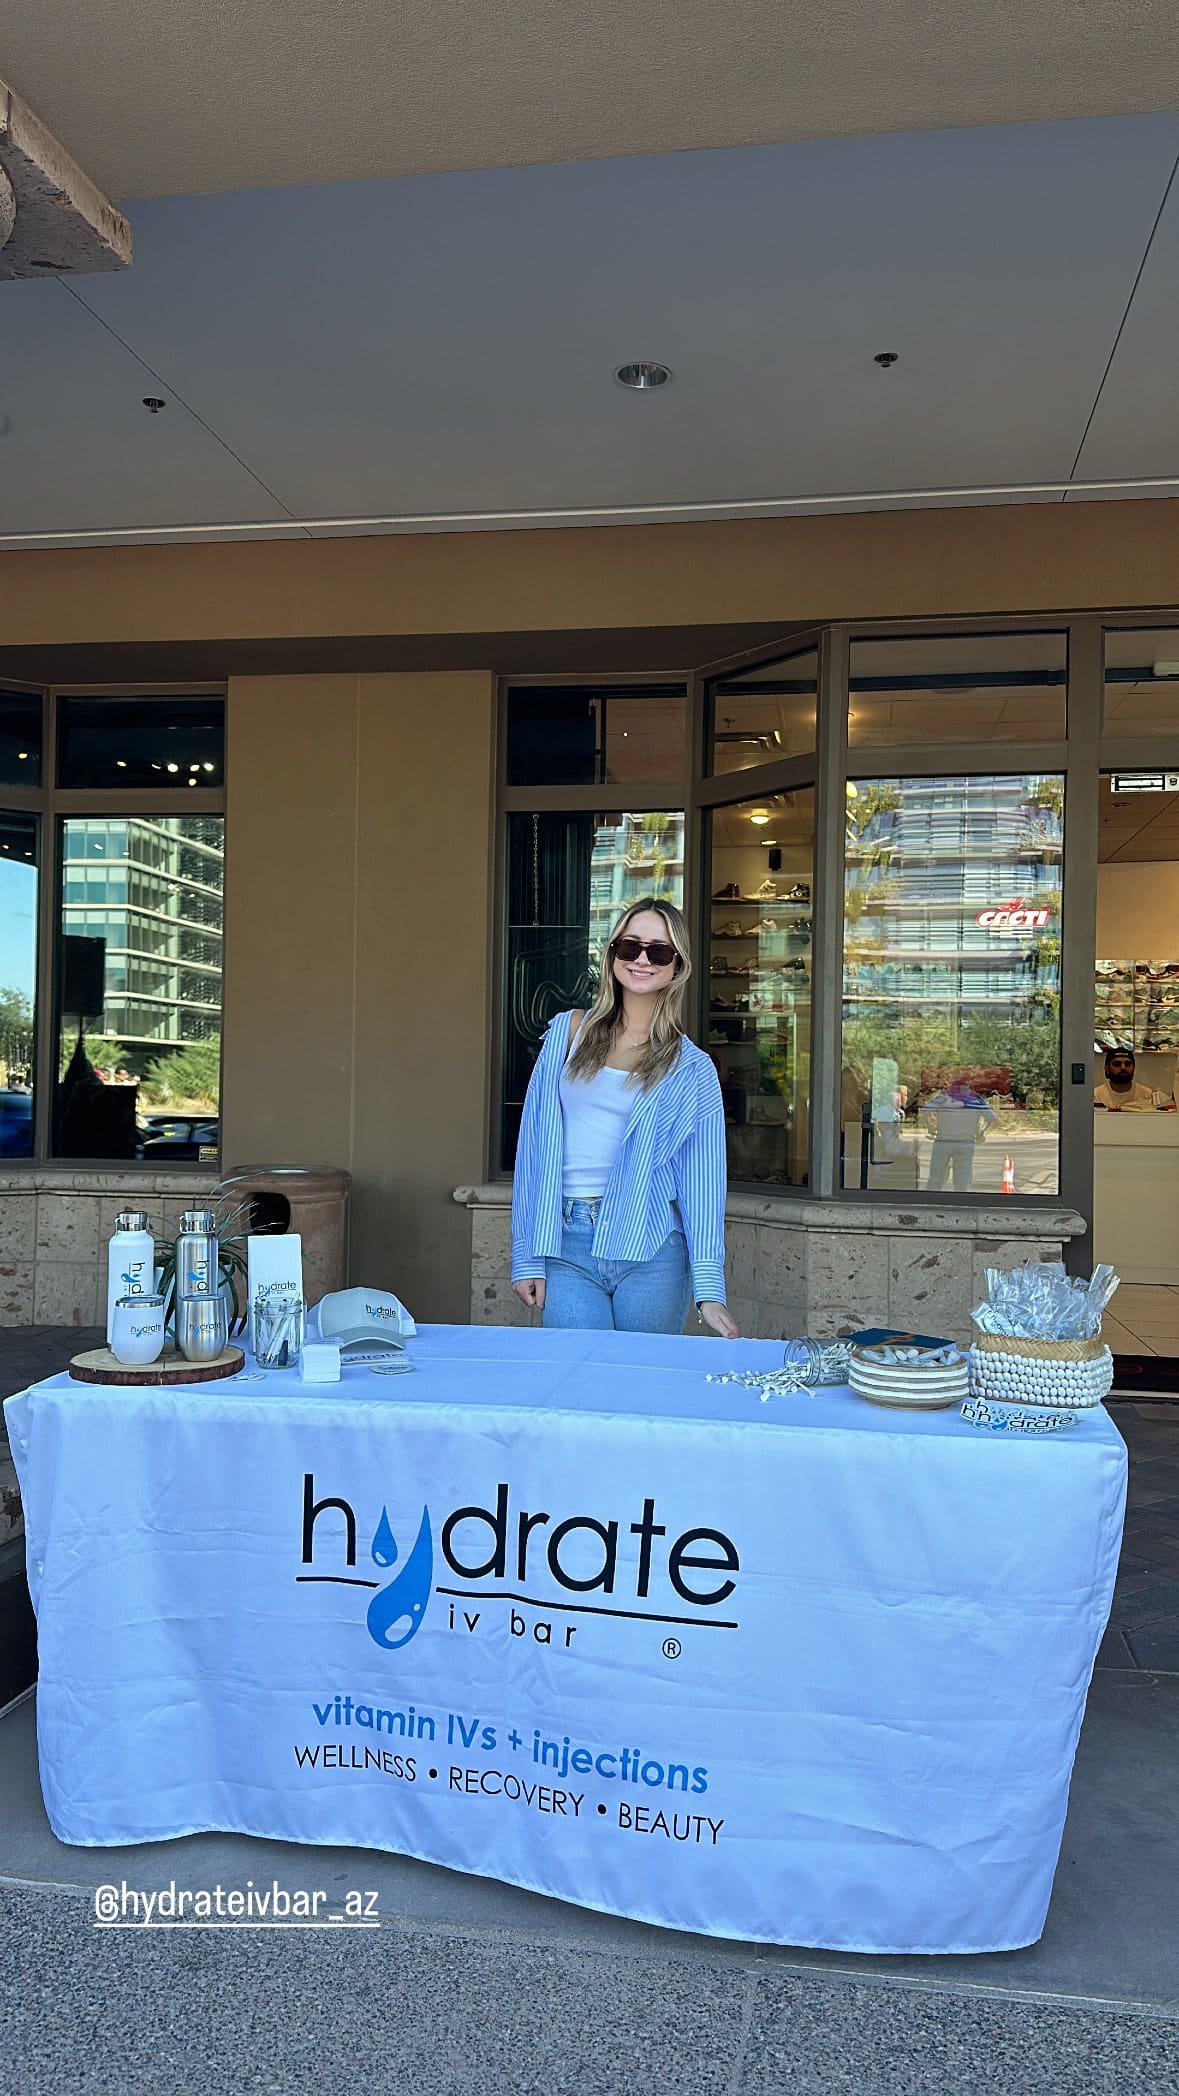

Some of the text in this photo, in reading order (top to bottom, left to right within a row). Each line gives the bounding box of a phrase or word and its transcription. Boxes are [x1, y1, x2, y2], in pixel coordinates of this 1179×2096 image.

[301, 1473, 740, 1650] hydrate
[448, 1602, 577, 1647] iv bar
[293, 1744, 725, 1845] WELLNESS RECOVERY BEAUTY
[311, 1695, 435, 1741] vitamin
[447, 1713, 497, 1751] IVs
[532, 1729, 709, 1795] injections
